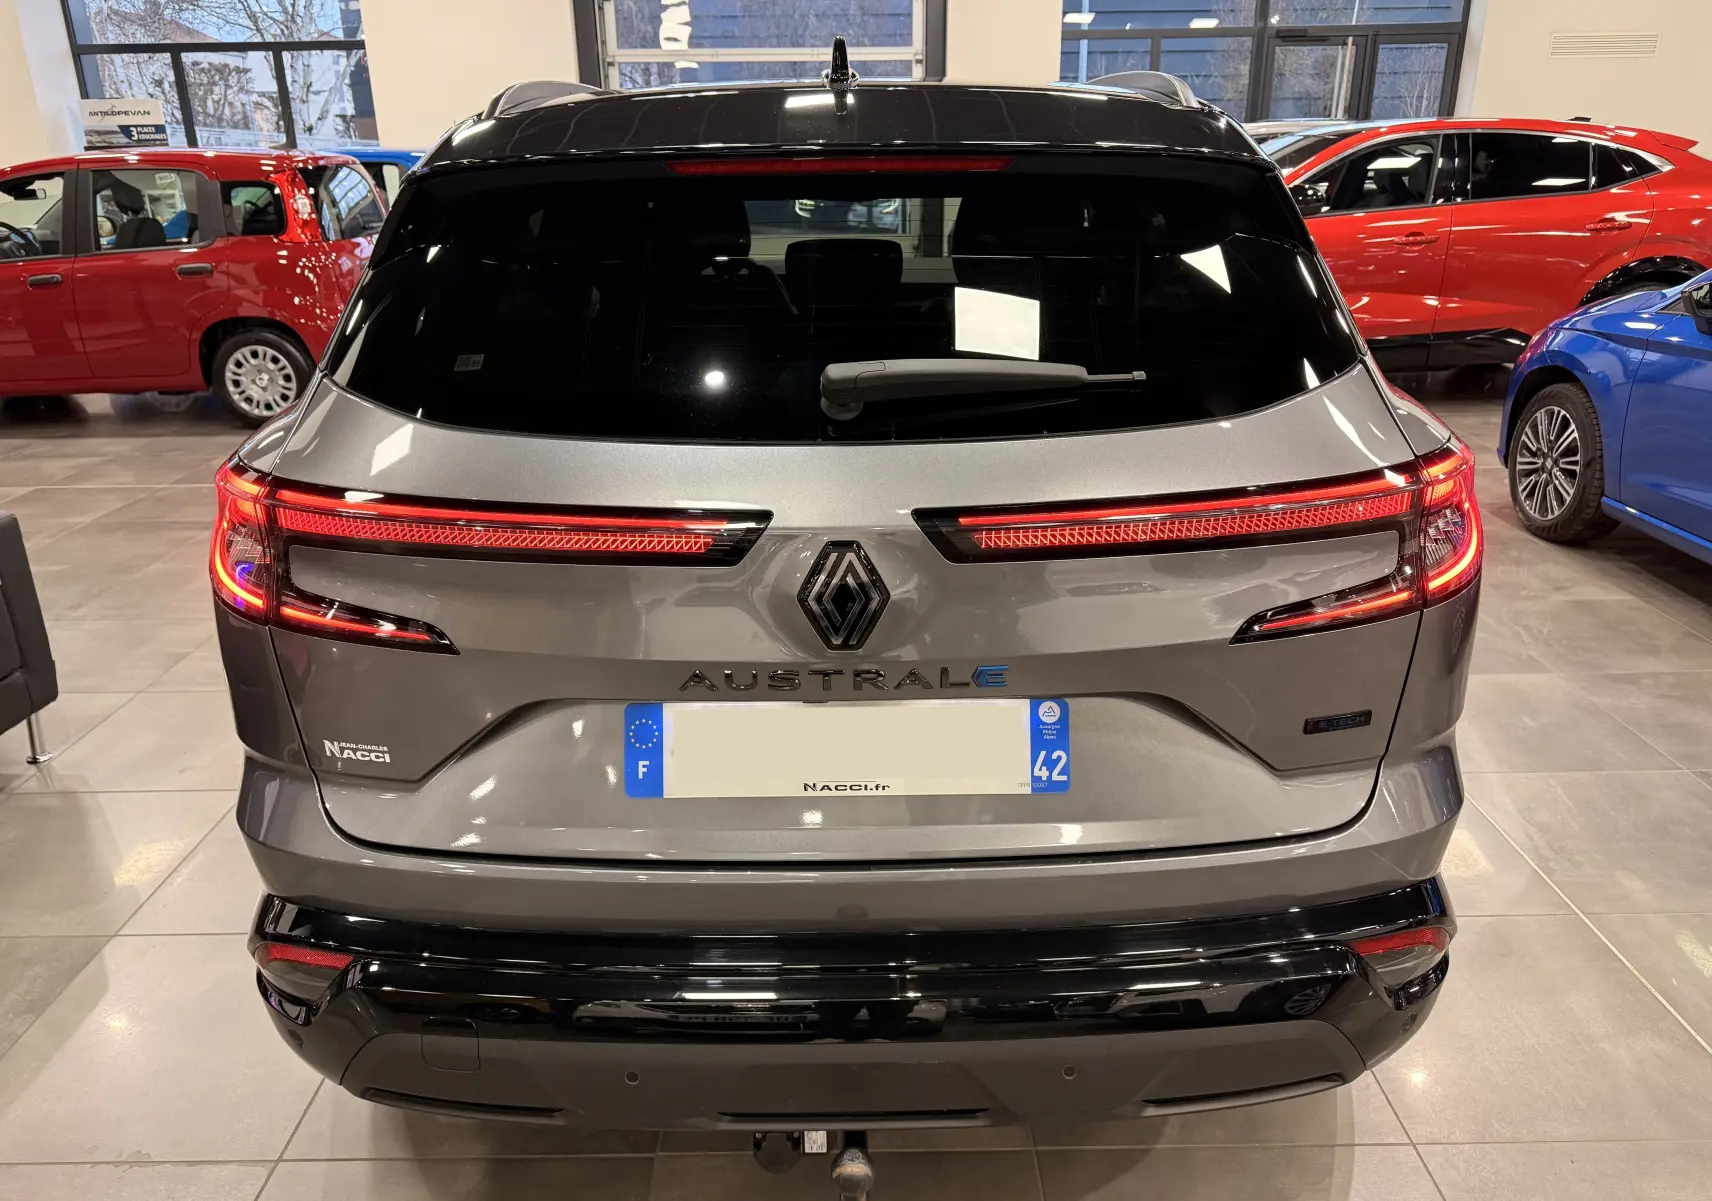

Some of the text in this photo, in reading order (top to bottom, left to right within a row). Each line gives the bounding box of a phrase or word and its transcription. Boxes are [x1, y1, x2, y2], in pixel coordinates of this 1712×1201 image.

[129, 127, 138, 140] 3
[1319, 715, 1365, 728] E-TECH
[322, 739, 391, 763] NACCI
[339, 742, 388, 752] JEAN-CHARLES
[638, 760, 650, 779] F
[1033, 750, 1068, 781] 42
